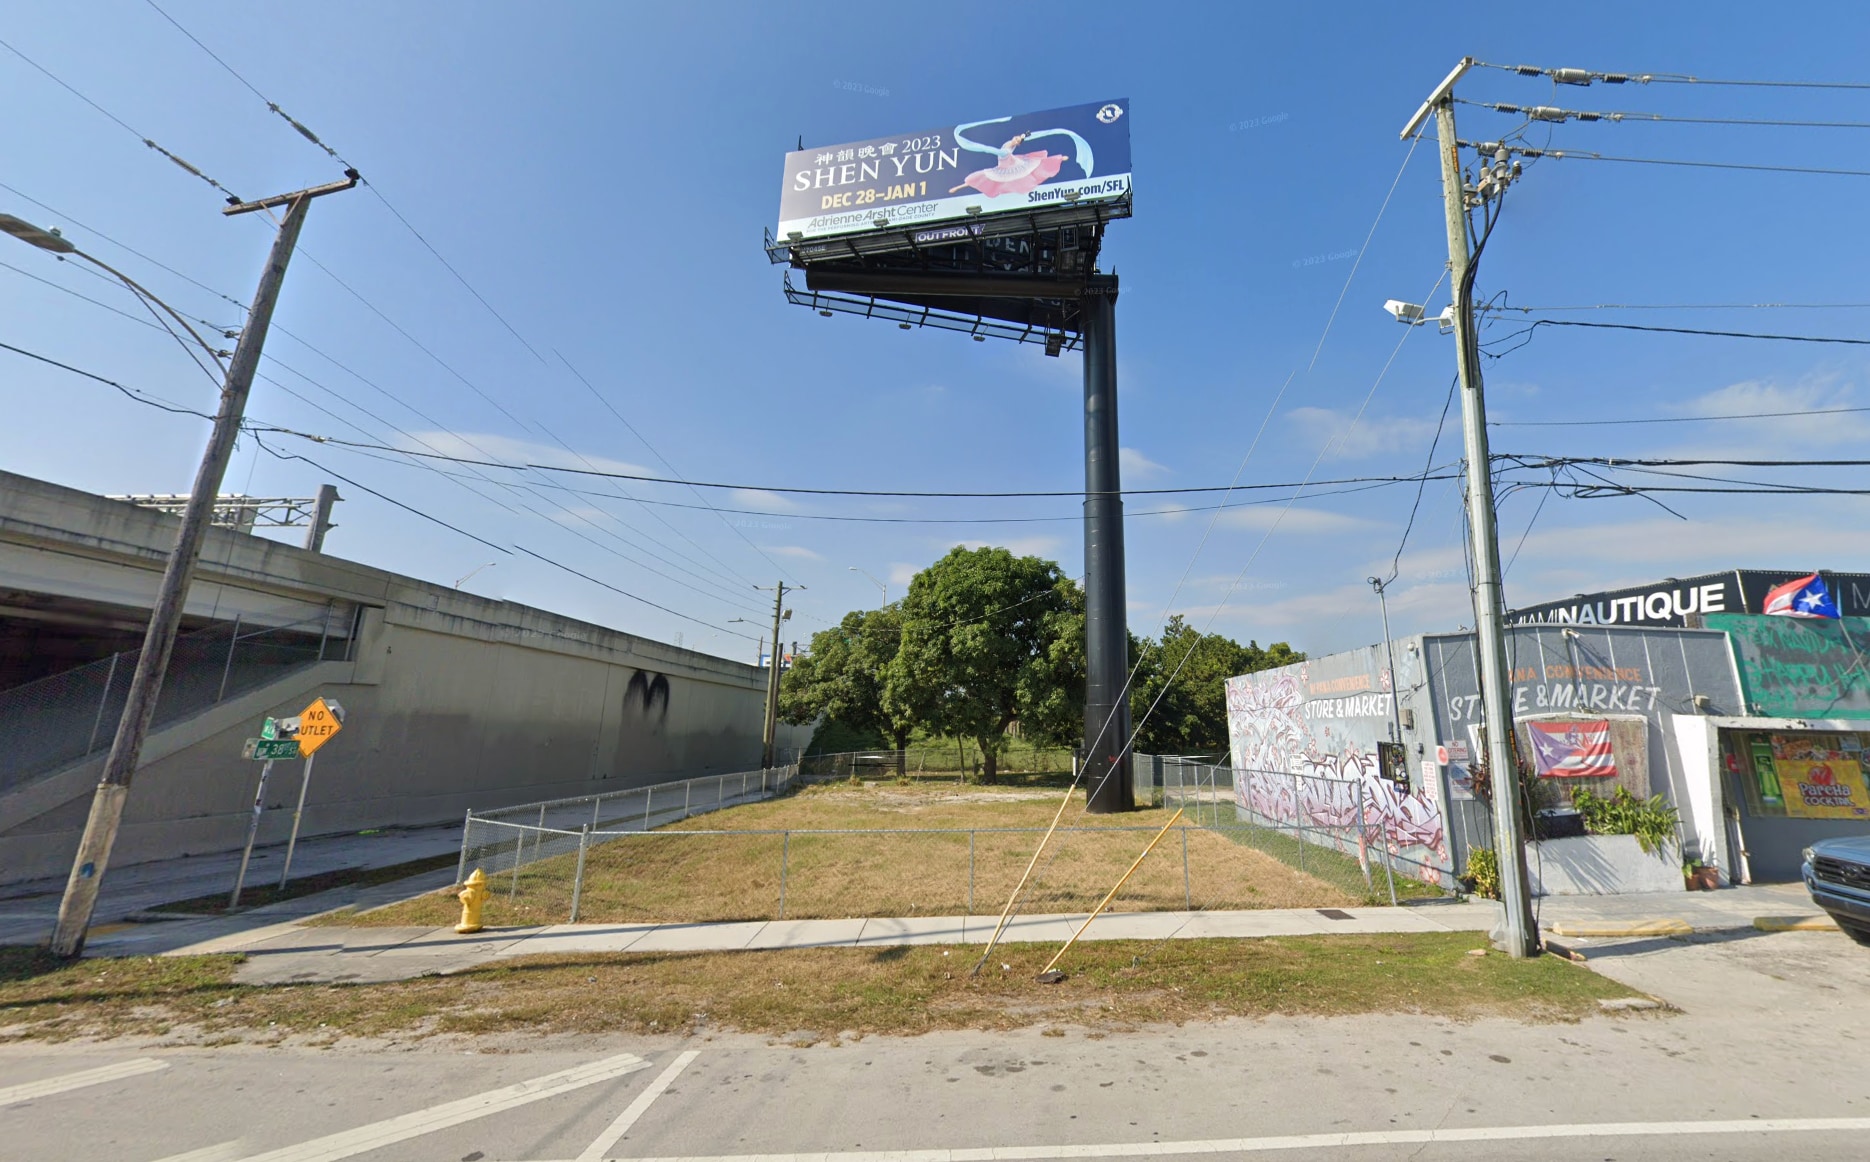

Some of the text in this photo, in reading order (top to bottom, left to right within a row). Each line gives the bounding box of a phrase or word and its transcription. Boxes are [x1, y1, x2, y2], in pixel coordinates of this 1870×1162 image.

[902, 135, 941, 153] 2023
[793, 147, 960, 191] SHEN YUN
[821, 192, 852, 210] DEC
[920, 181, 927, 196] 1
[807, 203, 938, 229] Adrienne Arsht Center
[1305, 693, 1392, 719] STORE & MARKET
[1450, 683, 1661, 720] STE & MARKET
[308, 710, 324, 721] NO
